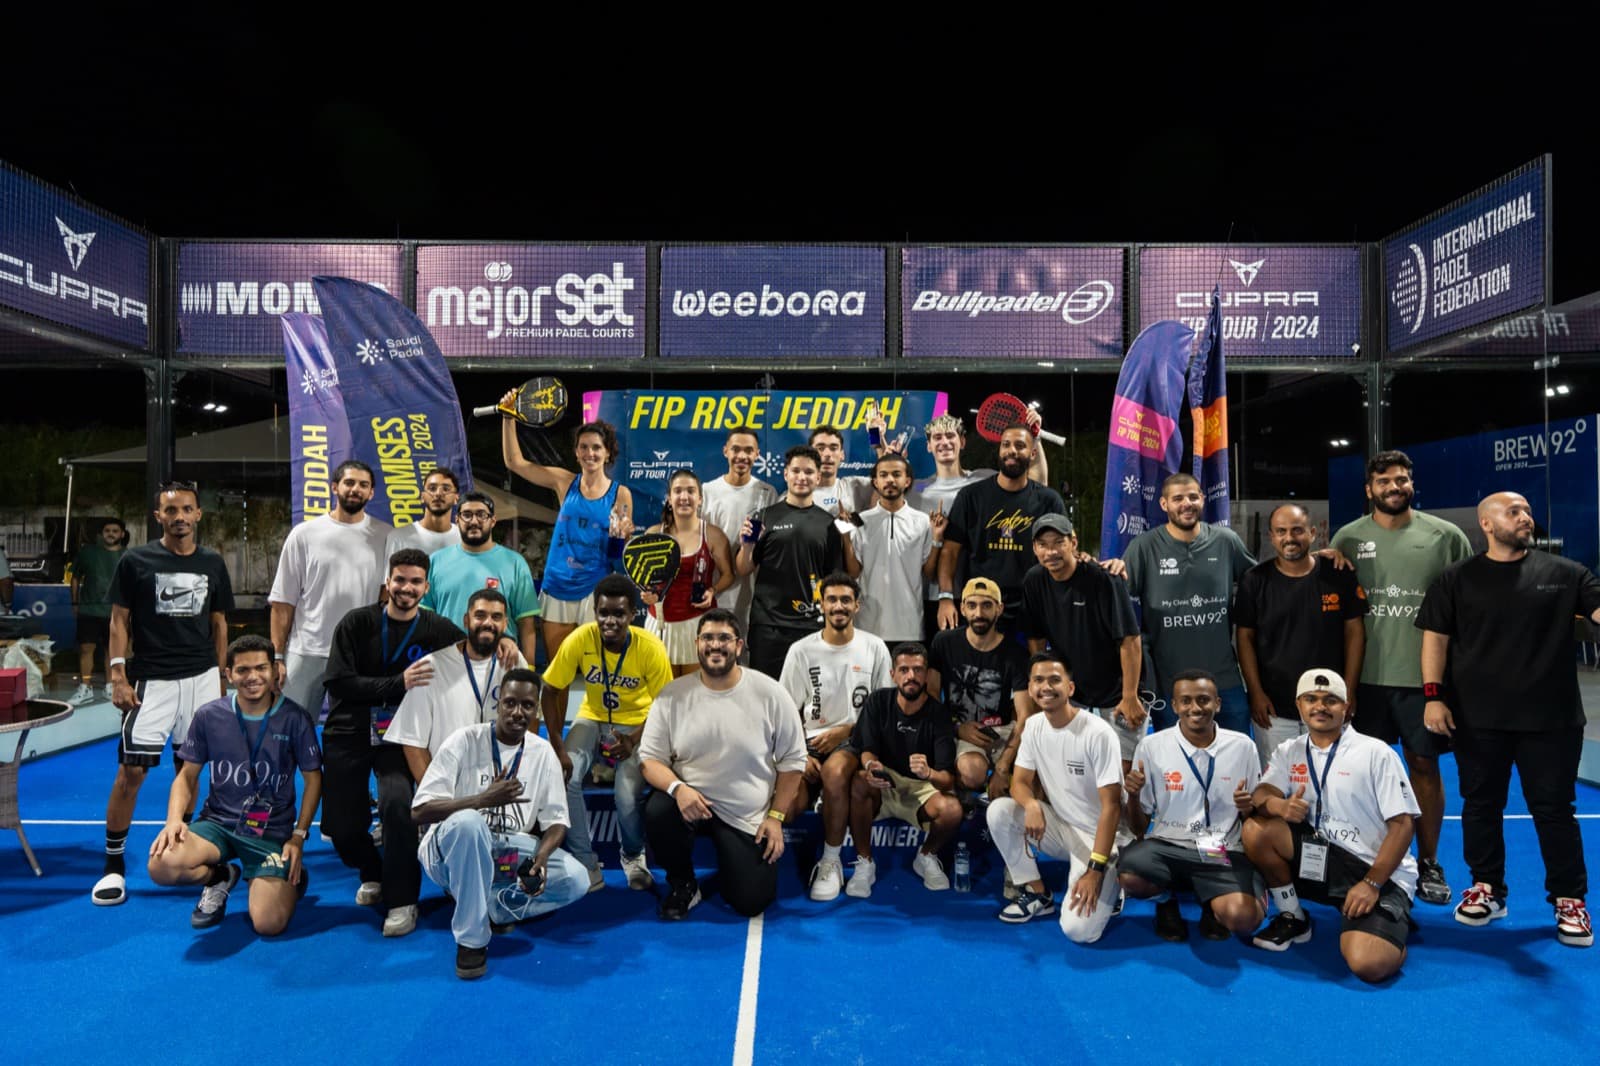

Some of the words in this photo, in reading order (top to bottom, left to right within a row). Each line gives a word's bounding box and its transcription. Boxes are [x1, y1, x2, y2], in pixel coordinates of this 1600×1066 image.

[1432, 192, 1536, 264] INTERNATIONAL
[1432, 253, 1472, 292] PADEL
[0, 252, 148, 326] CUPRA
[1175, 291, 1319, 308] CUPRA
[1432, 263, 1511, 319] FEDERATION
[911, 290, 1064, 318] Bullpadel
[505, 328, 554, 339] PREMIUM
[555, 328, 590, 339] PADEL
[592, 328, 635, 339] COURTS
[1221, 315, 1259, 340] OUR
[1271, 315, 1320, 339] 2024
[385, 335, 422, 349] Saudi
[629, 396, 686, 429] FIP
[690, 396, 770, 429] RISE
[771, 396, 903, 430] JEDDAH
[408, 413, 434, 451] 2024
[629, 461, 694, 469] CUPRA
[629, 469, 645, 480] FIP
[645, 469, 666, 480] TOUR
[1368, 603, 1421, 618] REW9
[602, 690, 620, 710] 6
[808, 665, 822, 721] Universe
[842, 826, 920, 847] RNNER
